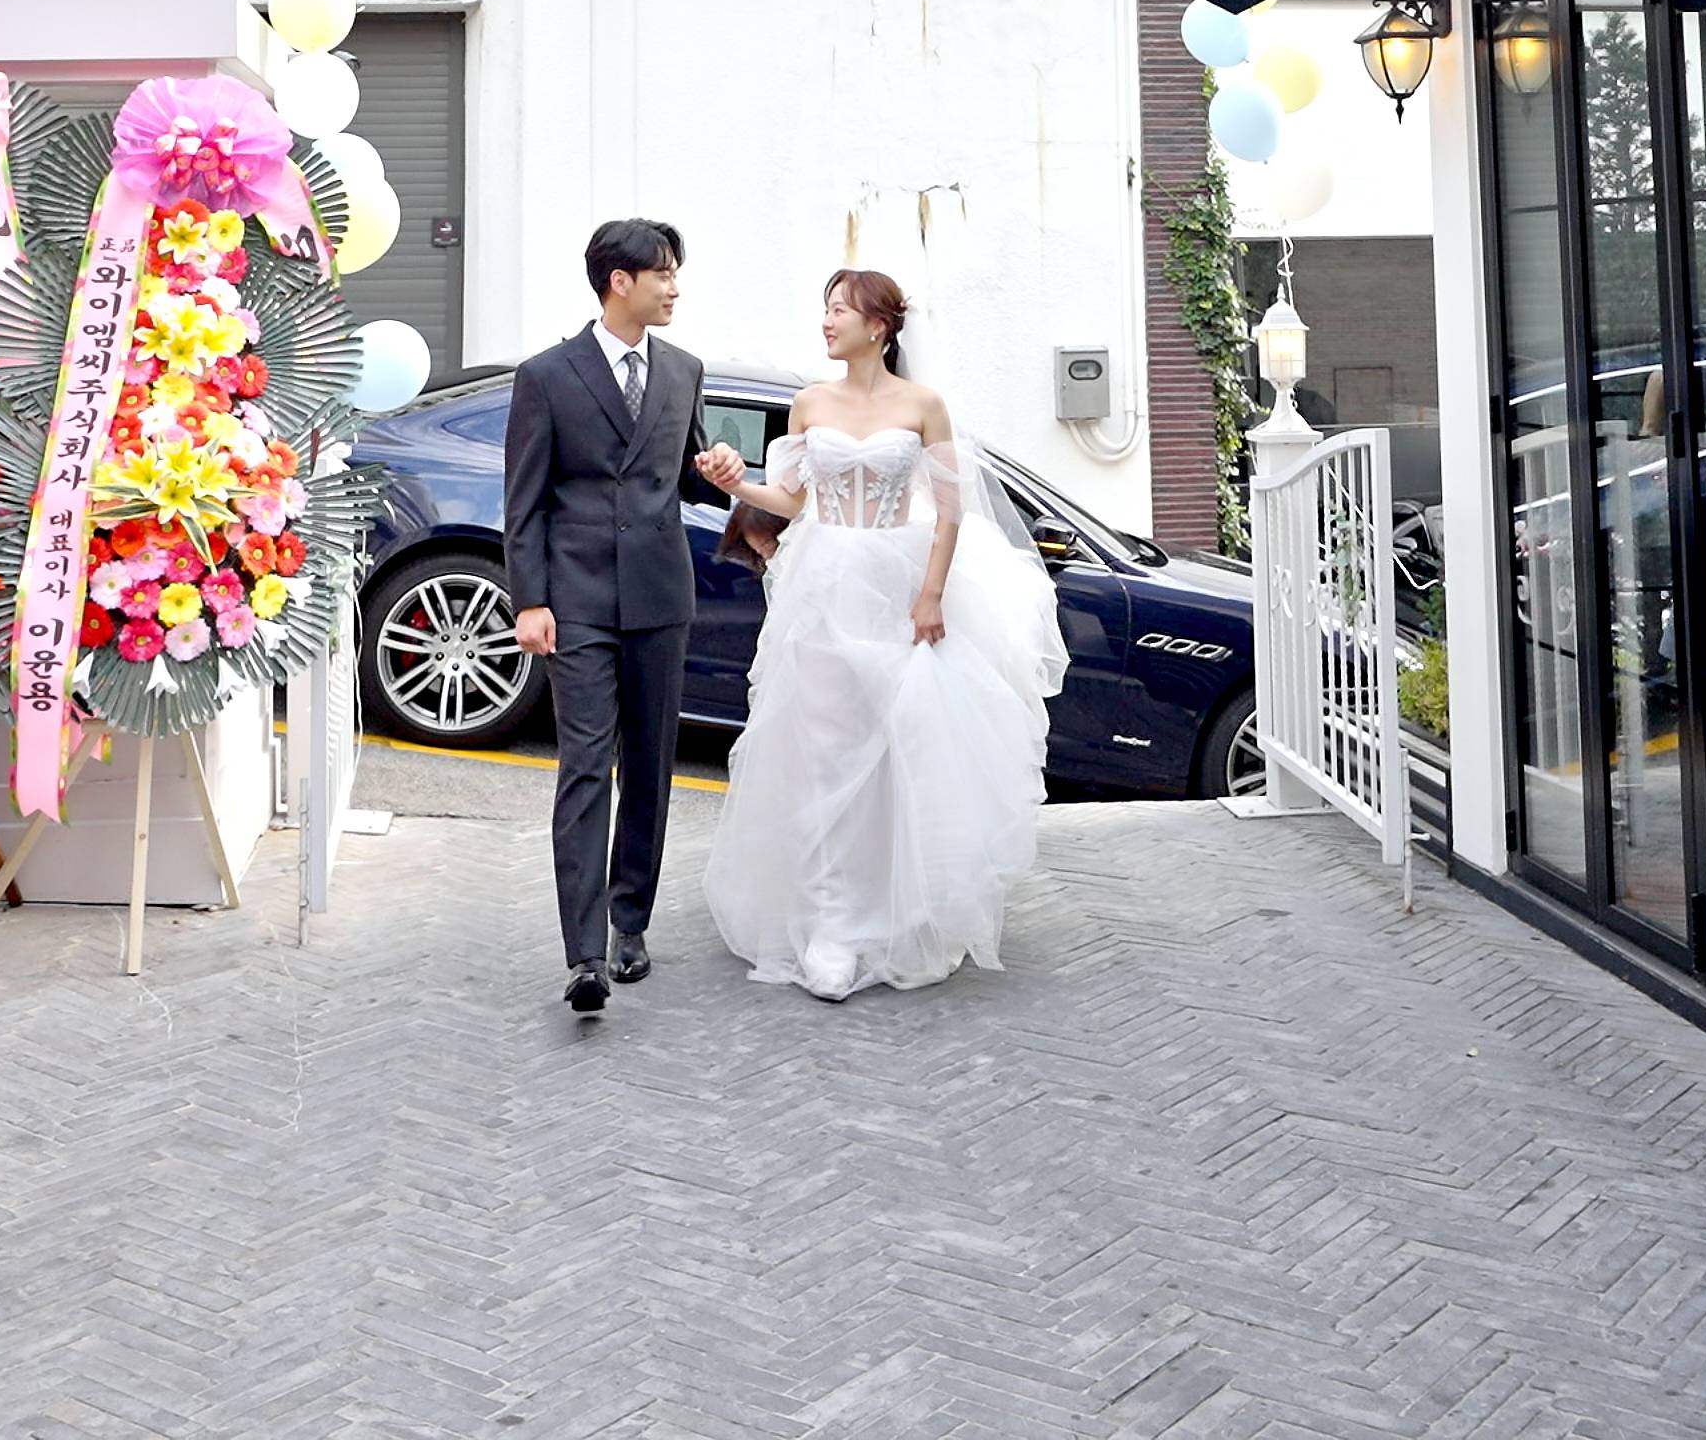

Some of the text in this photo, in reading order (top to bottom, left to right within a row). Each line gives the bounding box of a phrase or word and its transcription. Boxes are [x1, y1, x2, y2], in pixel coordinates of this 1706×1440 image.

[19, 264, 132, 712] 와이엠씨주식회사 대표이사 이윤용
